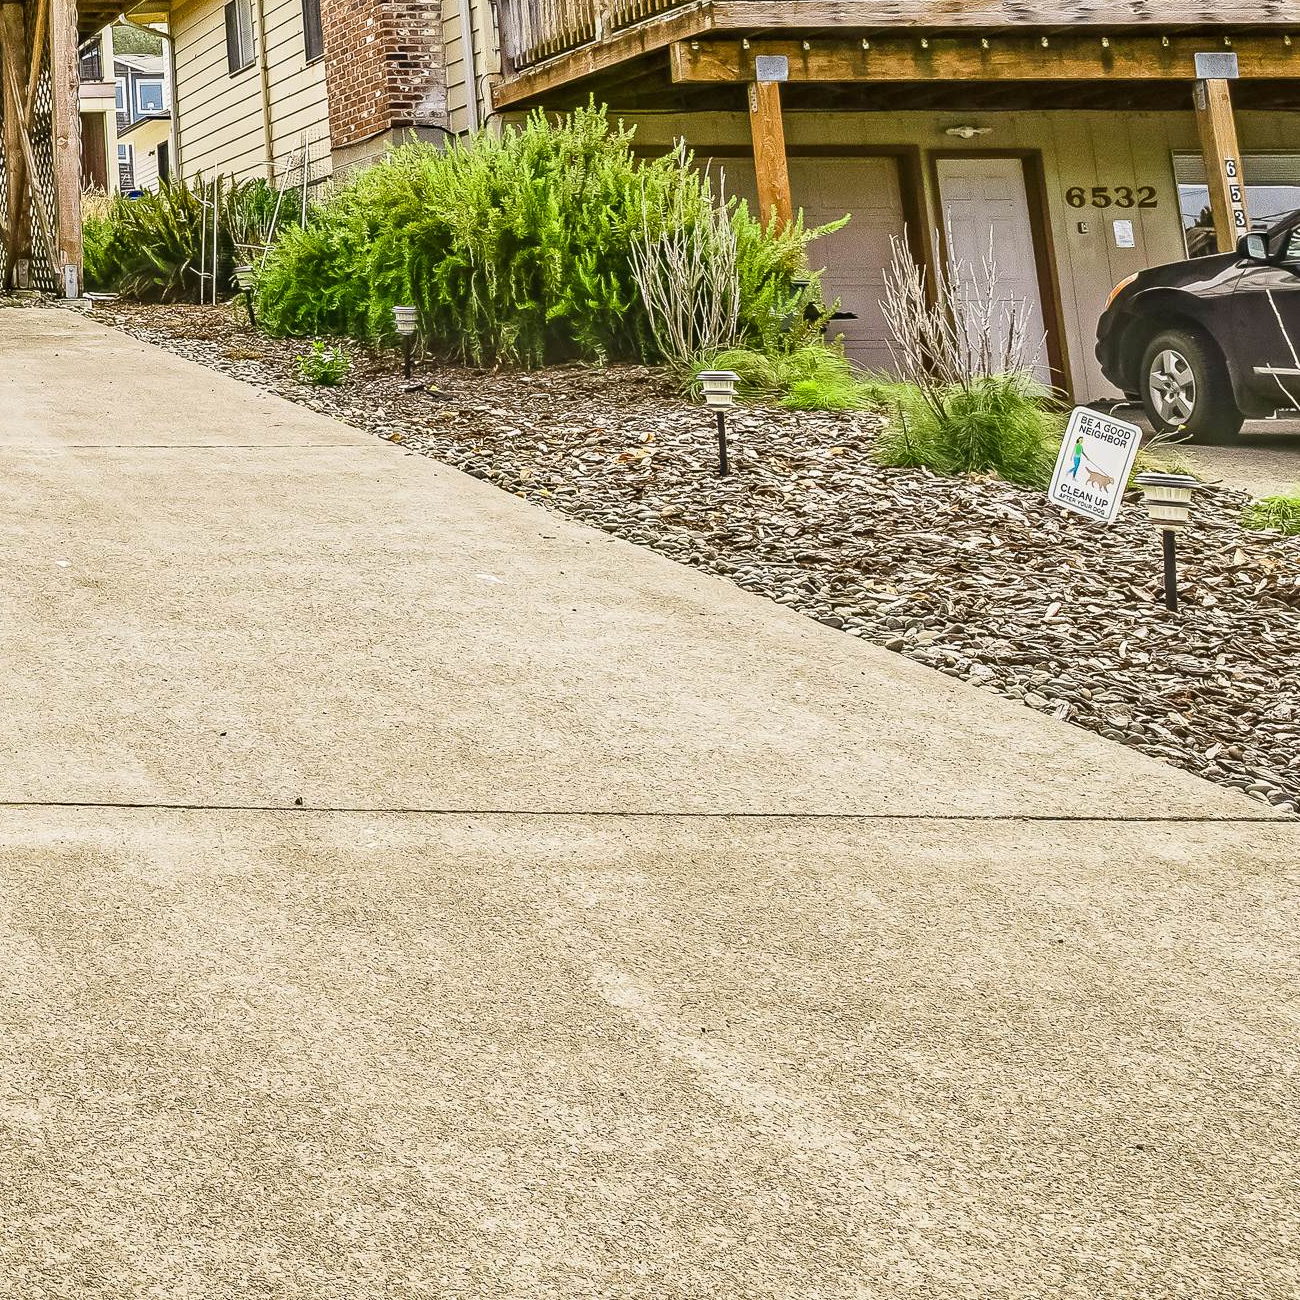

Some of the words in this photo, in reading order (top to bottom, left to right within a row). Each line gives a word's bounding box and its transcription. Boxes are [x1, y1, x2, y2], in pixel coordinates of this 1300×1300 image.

[1065, 186, 1158, 209] 6532
[1226, 160, 1246, 230] 653
[1079, 425, 1128, 448] NEIGHBOR
[1080, 415, 1094, 427] BE
[1094, 421, 1101, 430] A
[1103, 423, 1131, 440] GOOD
[1059, 493, 1077, 503] AFTER
[1077, 498, 1093, 510] YOUR
[1092, 505, 1105, 516] DOG
[1060, 483, 1093, 501] CLEAN
[1094, 496, 1109, 508] UP
